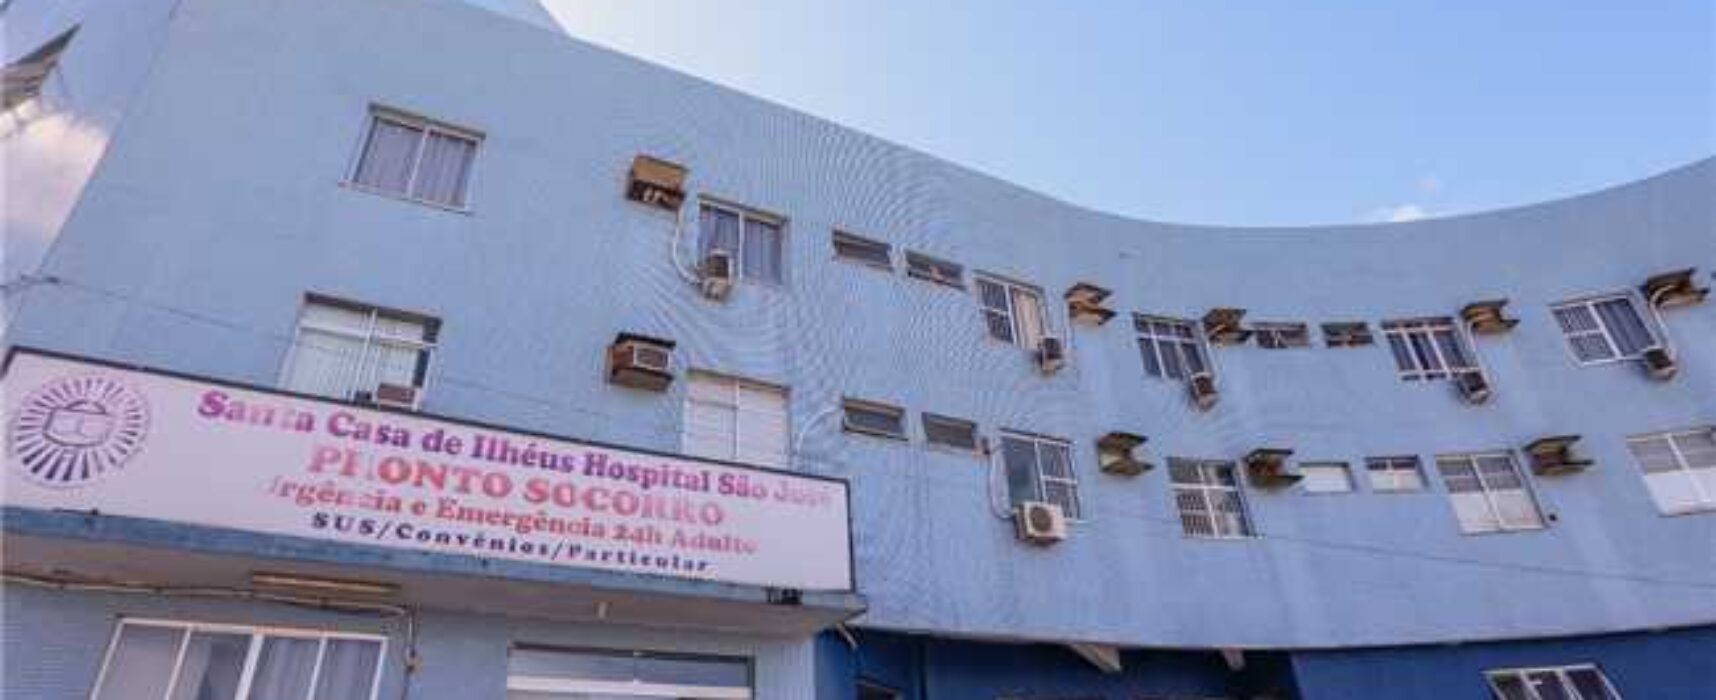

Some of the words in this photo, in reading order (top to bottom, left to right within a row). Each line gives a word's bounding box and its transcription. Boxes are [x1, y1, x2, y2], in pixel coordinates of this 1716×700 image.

[327, 410, 411, 449] Casa
[422, 429, 463, 456] de
[471, 433, 574, 473] Ilhéus
[583, 452, 710, 491] Hospital
[718, 474, 766, 501] São
[411, 498, 427, 516] e
[436, 498, 605, 538] Emergência
[524, 478, 724, 526] SOCORRO
